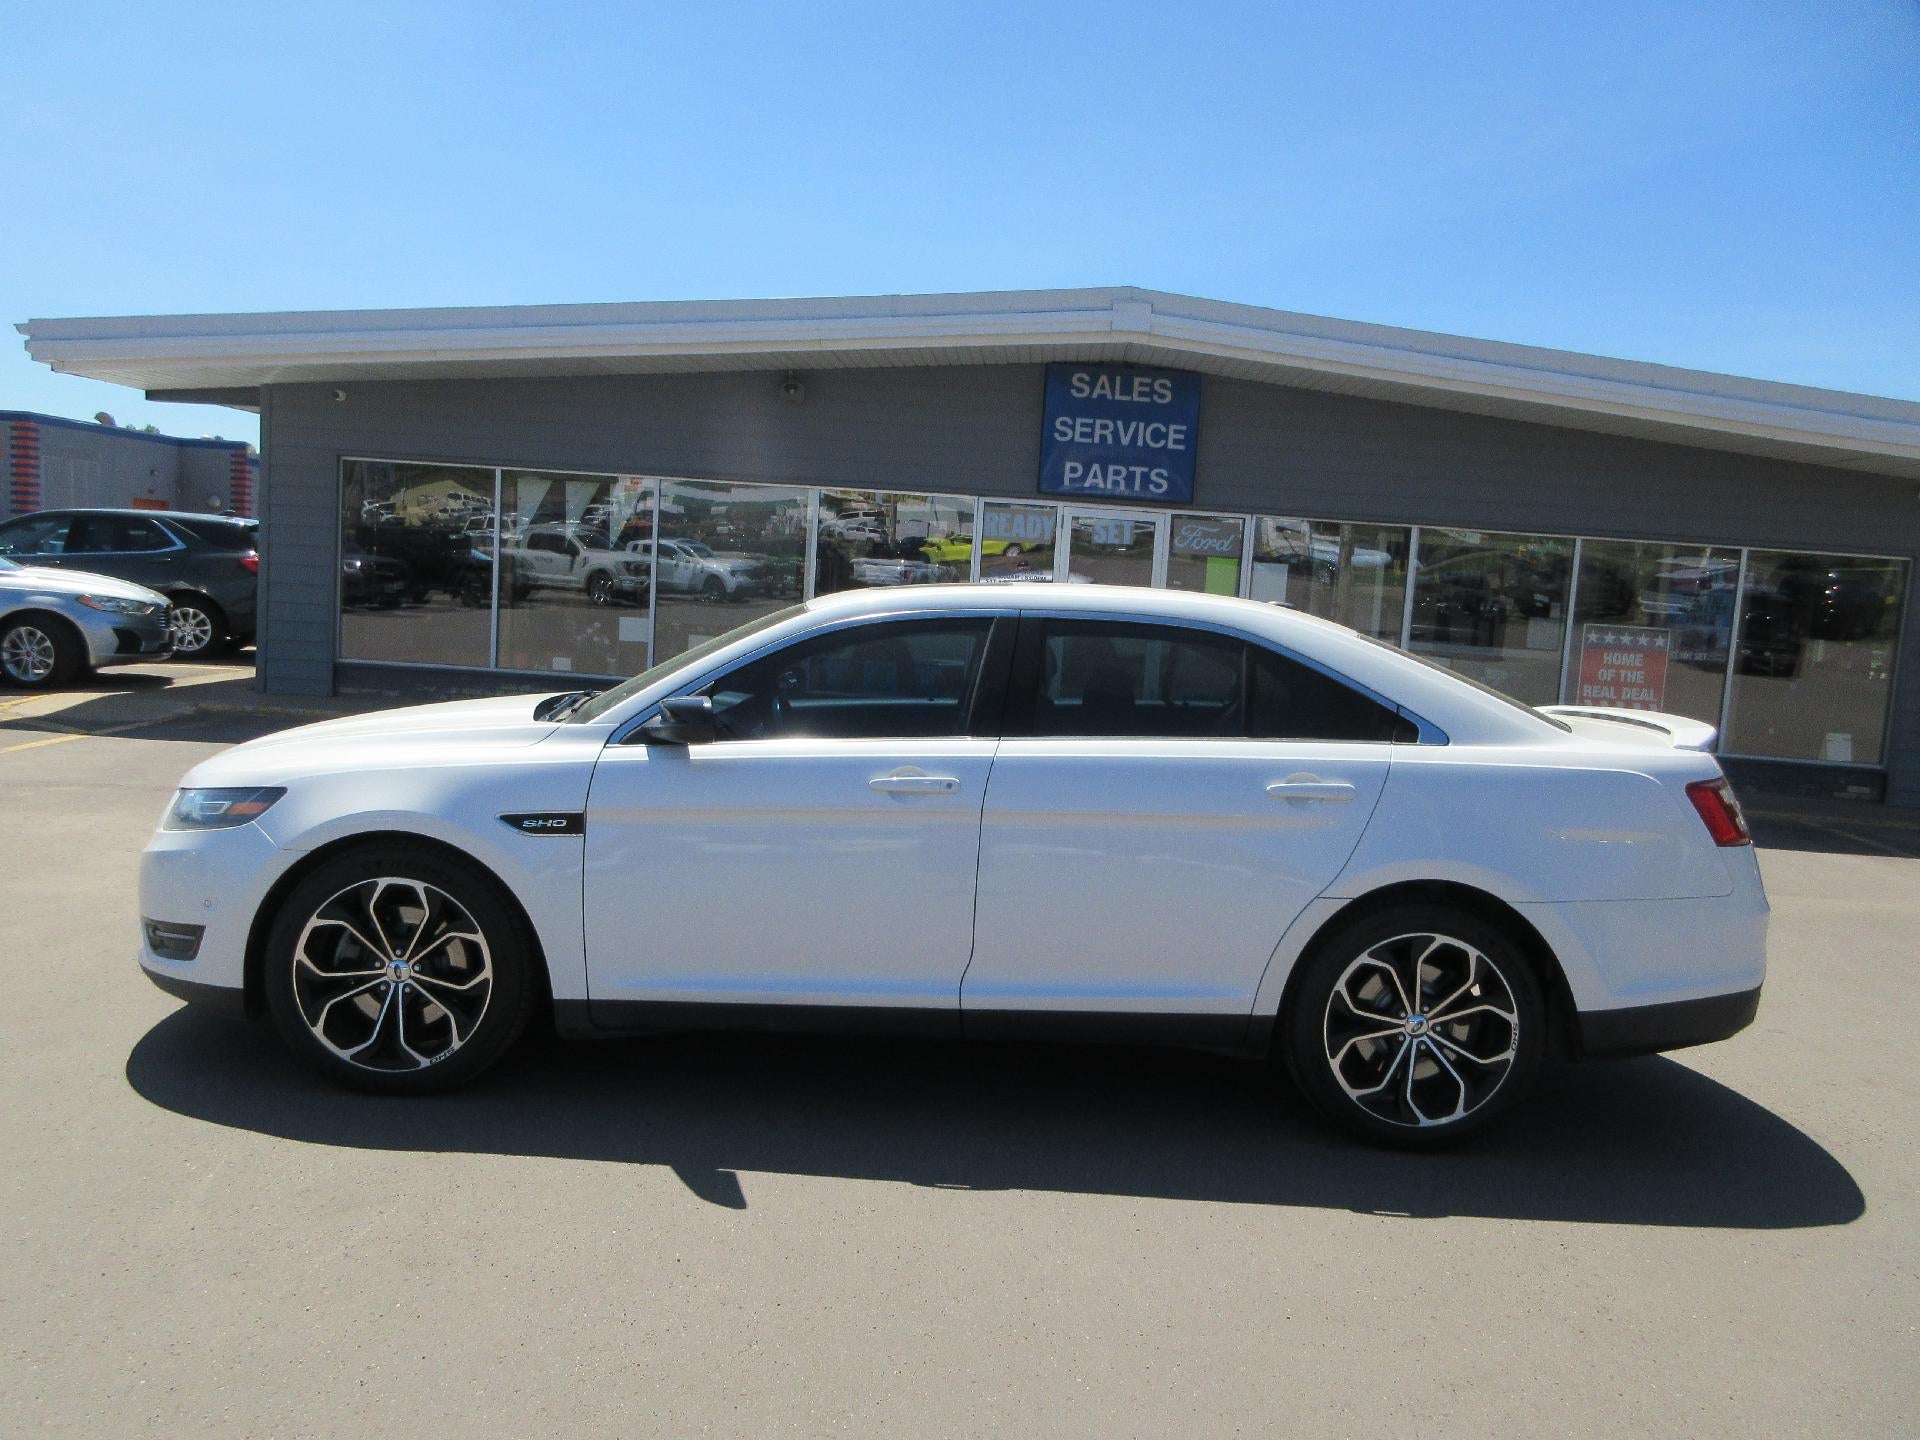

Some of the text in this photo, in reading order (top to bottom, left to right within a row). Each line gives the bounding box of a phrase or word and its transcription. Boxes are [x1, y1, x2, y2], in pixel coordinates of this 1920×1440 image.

[1070, 373, 1172, 404] SALES
[1054, 416, 1187, 450] SERVICE
[1063, 461, 1169, 494] PARTS
[984, 511, 1056, 540] READY
[1093, 520, 1134, 544] SET
[1176, 525, 1235, 552] Ford
[1604, 652, 1643, 666] HOME
[1599, 669, 1645, 684] OF THE
[1583, 684, 1657, 701] REAL DEAL
